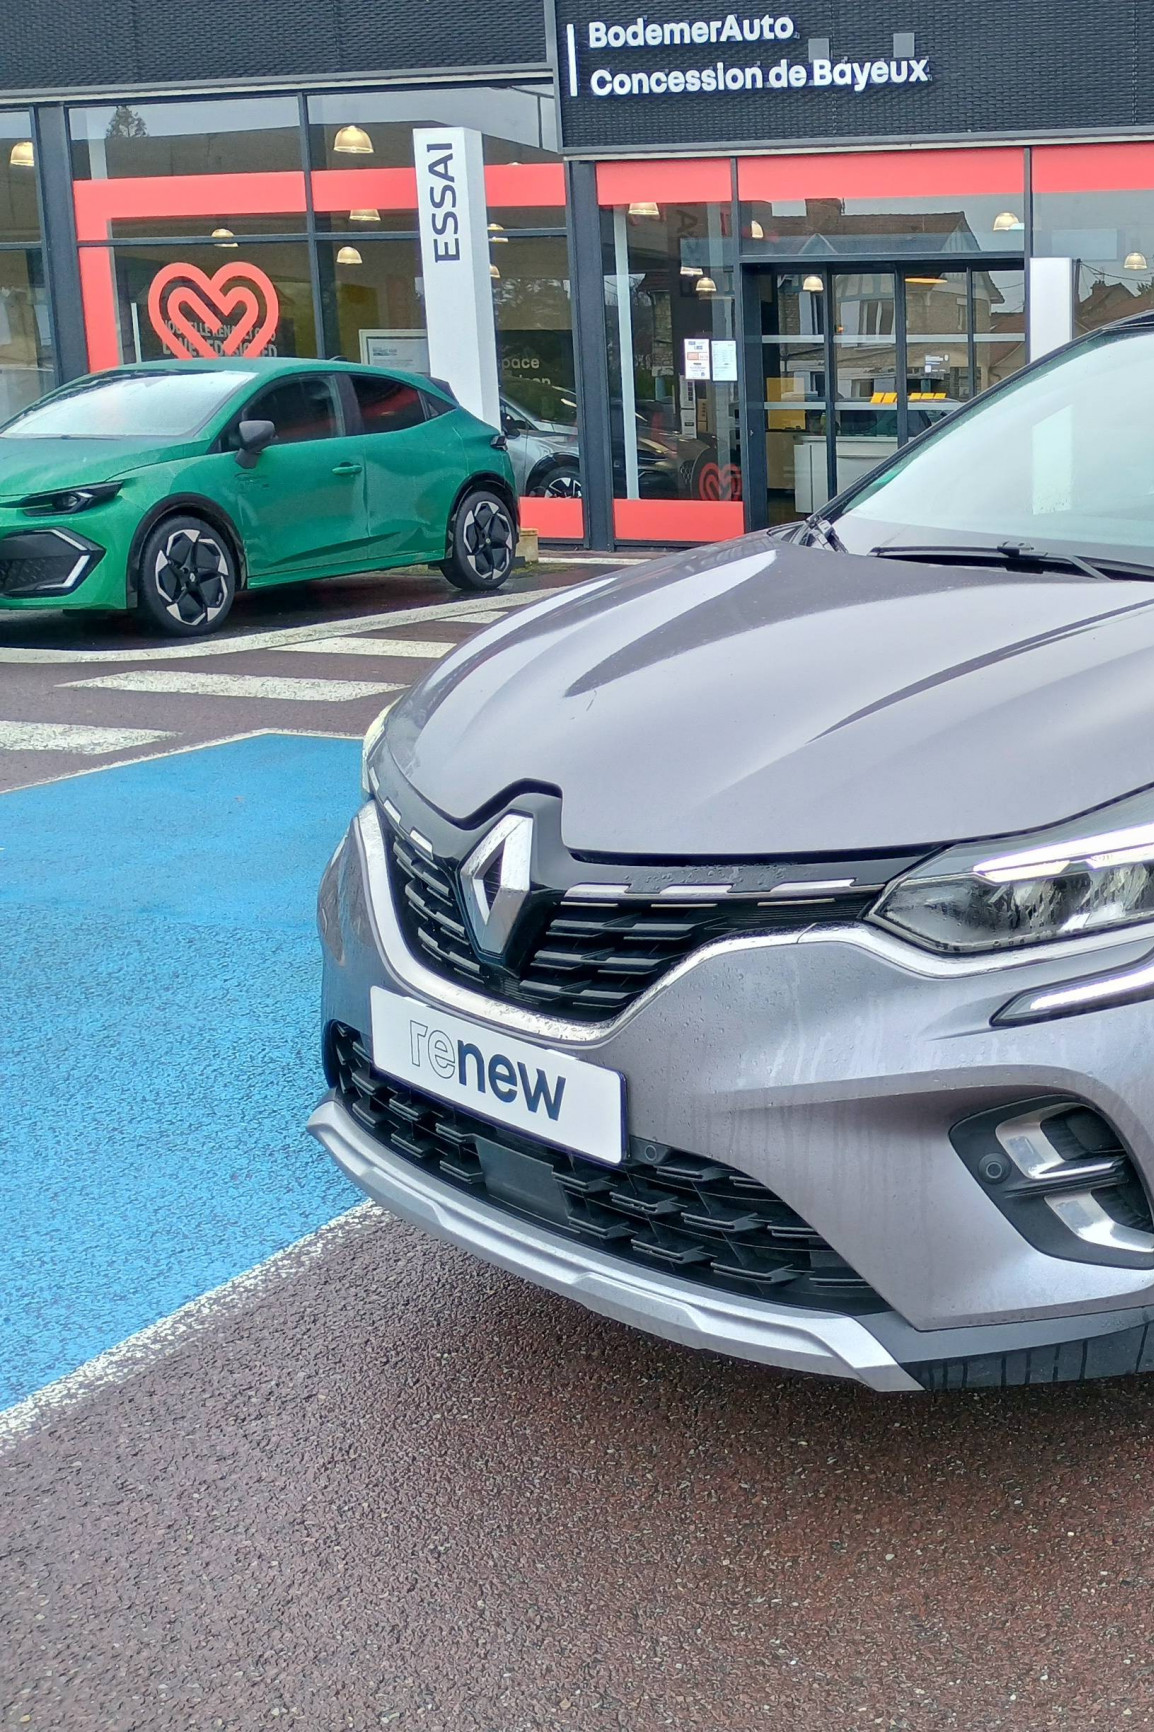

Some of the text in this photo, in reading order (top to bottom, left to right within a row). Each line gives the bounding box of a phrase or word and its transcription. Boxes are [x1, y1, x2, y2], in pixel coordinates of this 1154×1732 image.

[589, 14, 794, 48] BodemerAuto
[590, 57, 929, 96] Concession de Bayeux
[426, 143, 460, 263] ESSAI
[409, 1019, 567, 1122] renew
